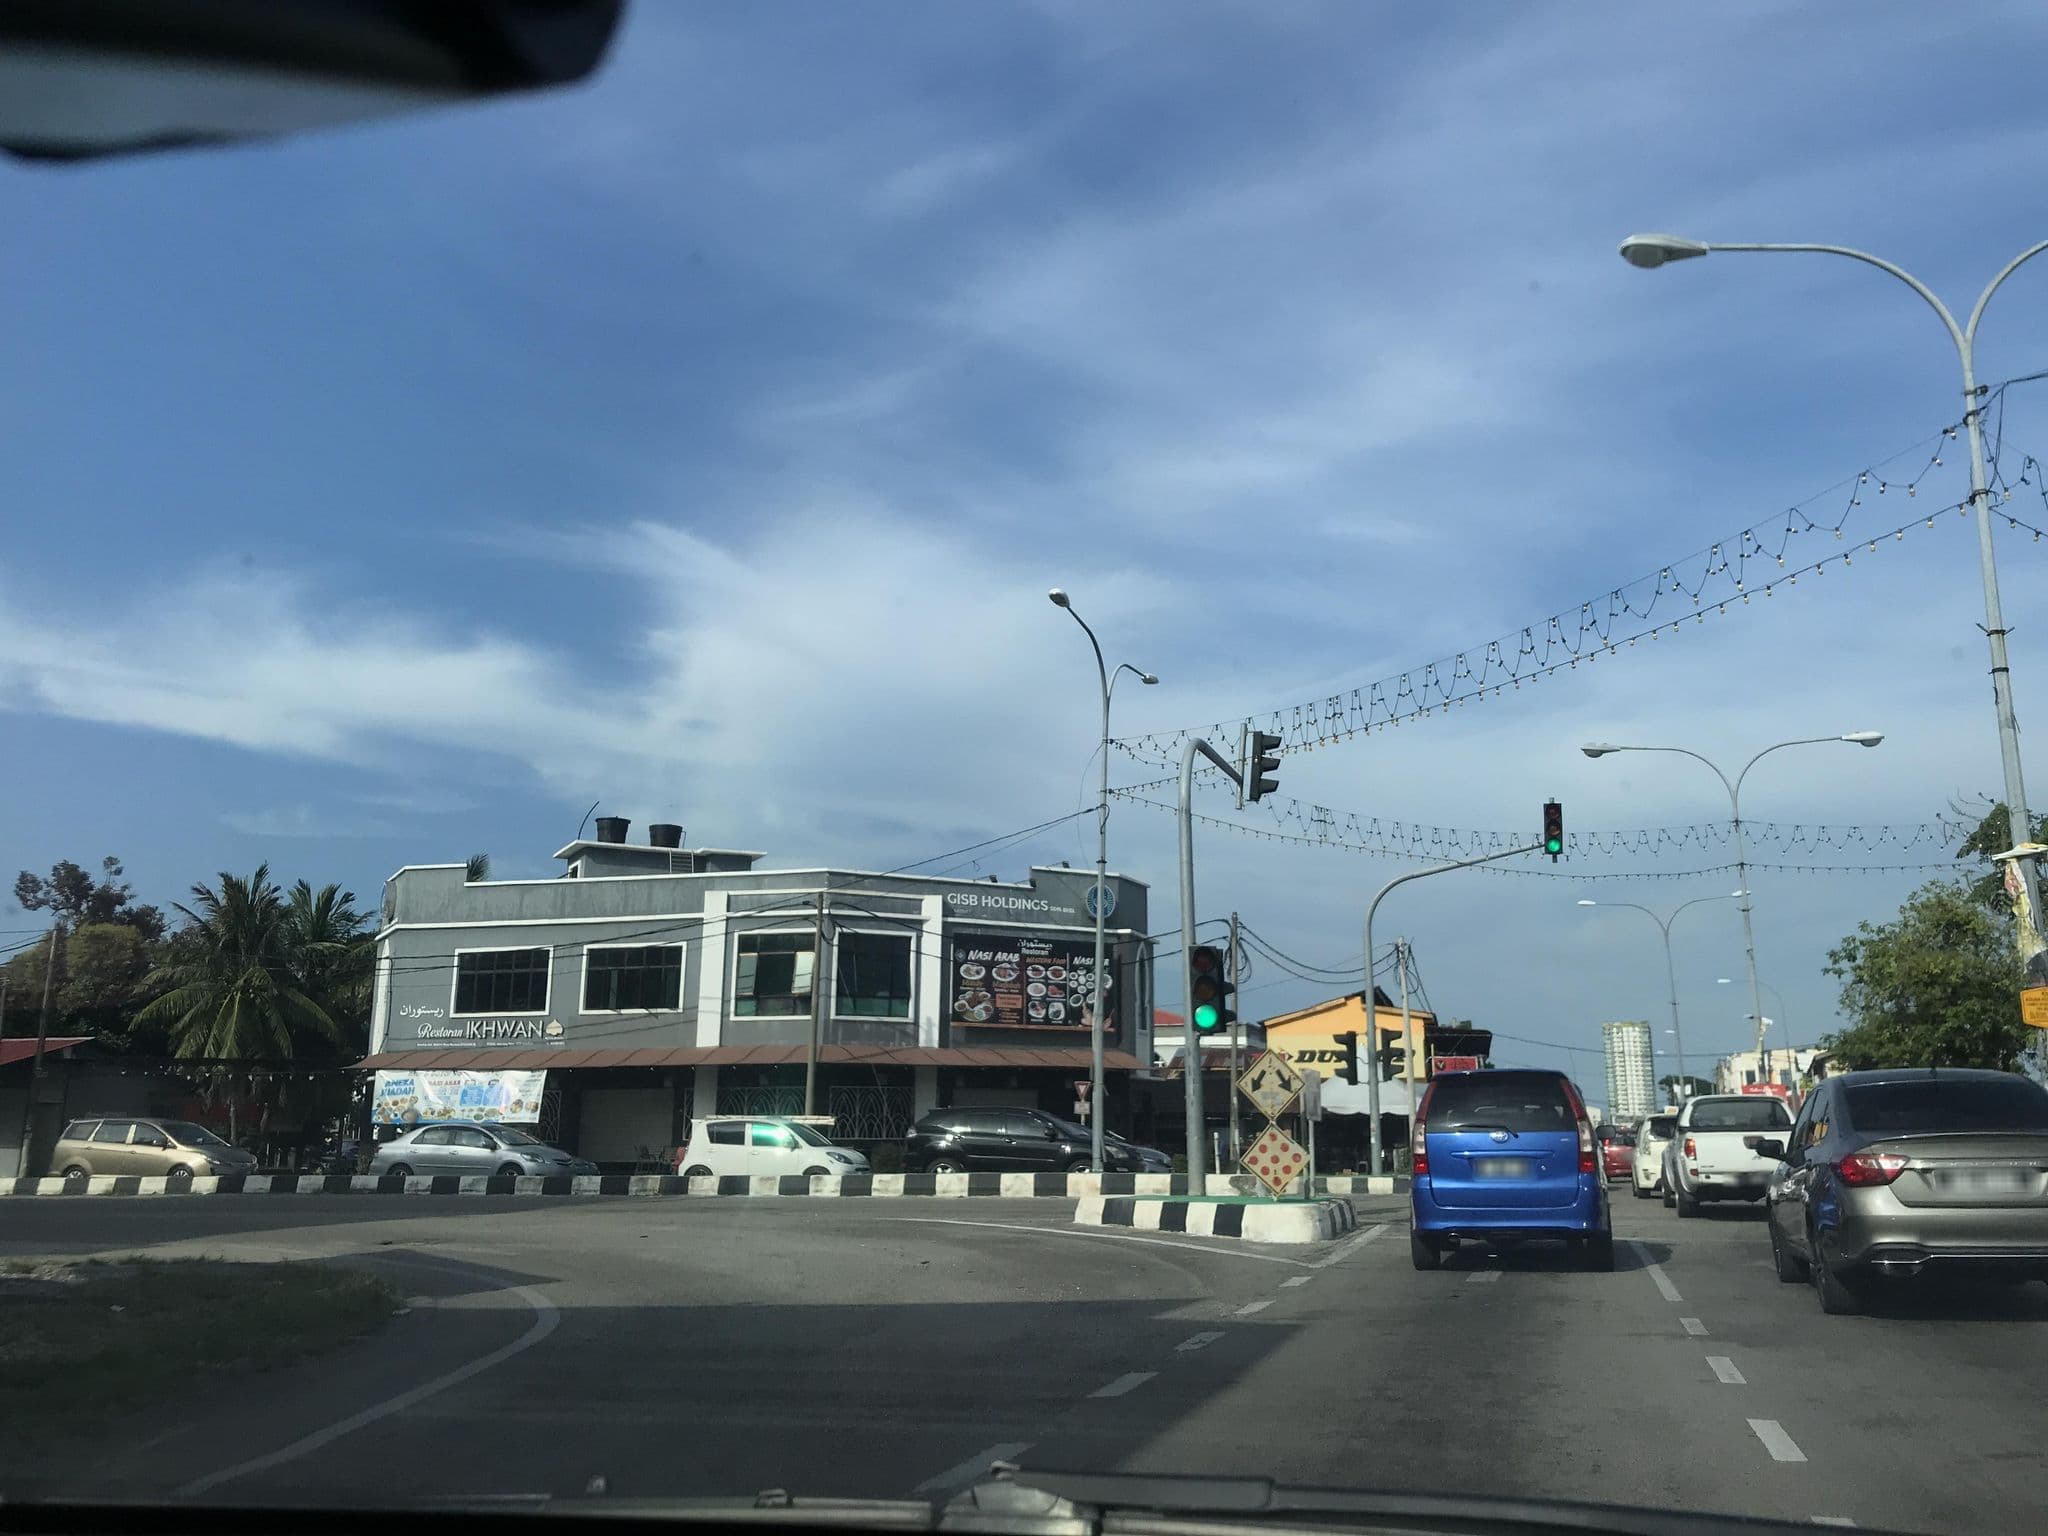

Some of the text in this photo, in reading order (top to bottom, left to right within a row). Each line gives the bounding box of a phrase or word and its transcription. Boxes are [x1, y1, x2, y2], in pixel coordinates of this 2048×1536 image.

[947, 893, 978, 906] GISB
[981, 895, 1049, 911] HOLDINGS
[967, 949, 1020, 962] NASI ARAB
[1072, 955, 1094, 965] NASI
[400, 1004, 444, 1017] ريستوران
[417, 1020, 544, 1039] Restoran IKHWAN
